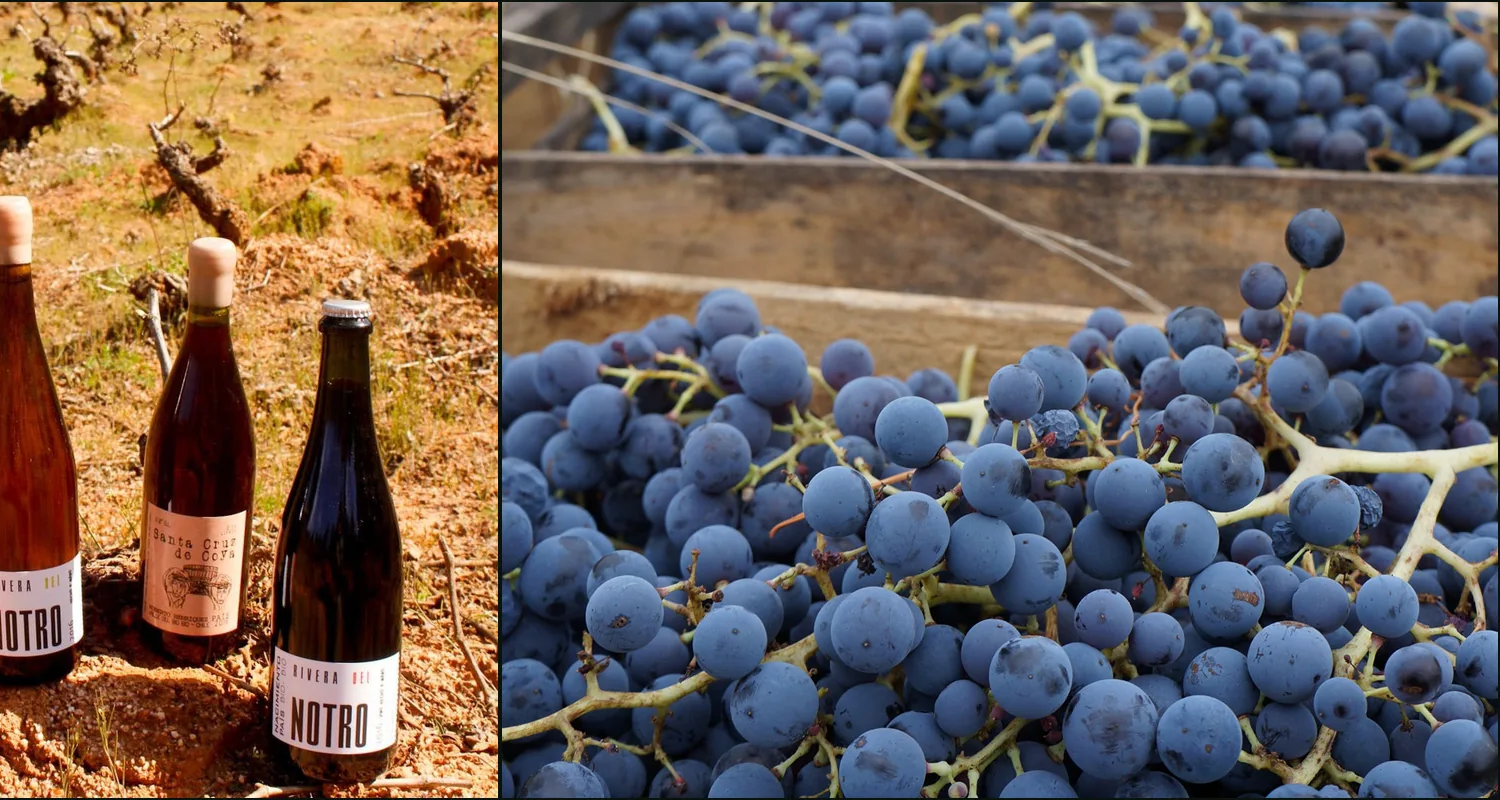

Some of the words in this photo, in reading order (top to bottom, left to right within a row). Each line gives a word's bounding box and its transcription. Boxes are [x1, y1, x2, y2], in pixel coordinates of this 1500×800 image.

[153, 527, 193, 549] Santa
[203, 536, 237, 550] Cruz
[175, 548, 192, 561] de
[201, 548, 236, 562] Coya
[43, 574, 60, 589] DEL
[292, 664, 338, 685] RIVERA
[352, 671, 370, 685] DEL
[290, 696, 368, 749] NOTRO
